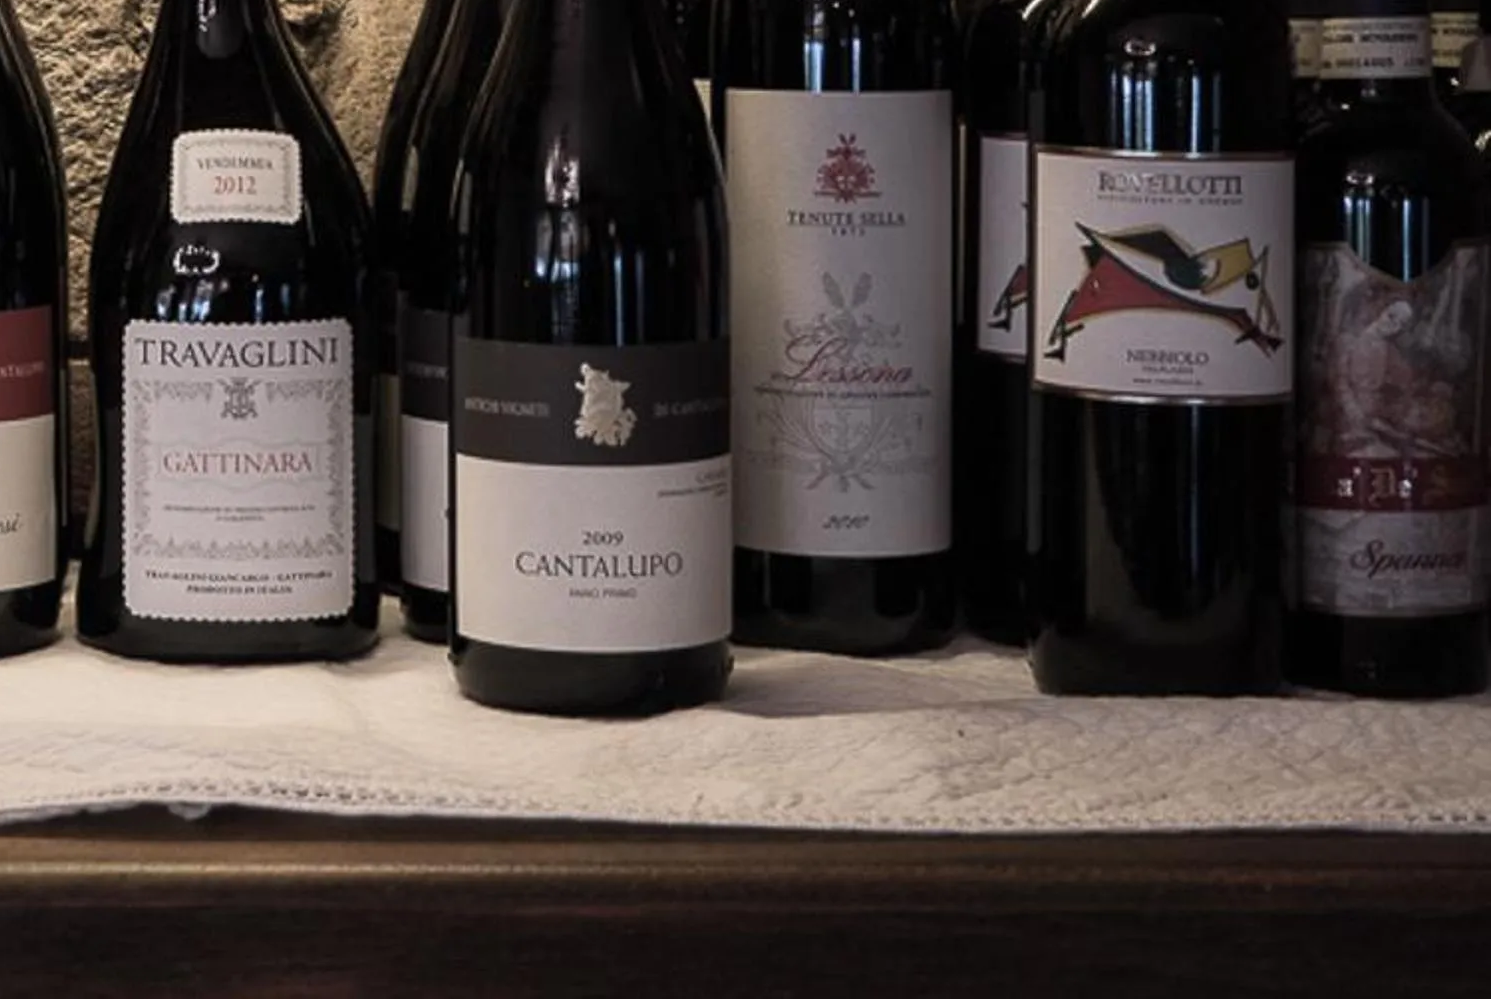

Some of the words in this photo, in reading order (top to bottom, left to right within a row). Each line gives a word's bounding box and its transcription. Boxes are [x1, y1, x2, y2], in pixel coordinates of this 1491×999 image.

[214, 175, 258, 196] 2012
[1098, 172, 1243, 196] ROVELLOTTI
[787, 210, 852, 226] TENUTE
[861, 211, 905, 226] SELLA
[135, 337, 339, 369] TRAVAGLINI
[163, 452, 312, 474] GATTINARA
[582, 530, 624, 546] 2009
[514, 551, 684, 578] CANTALUPO
